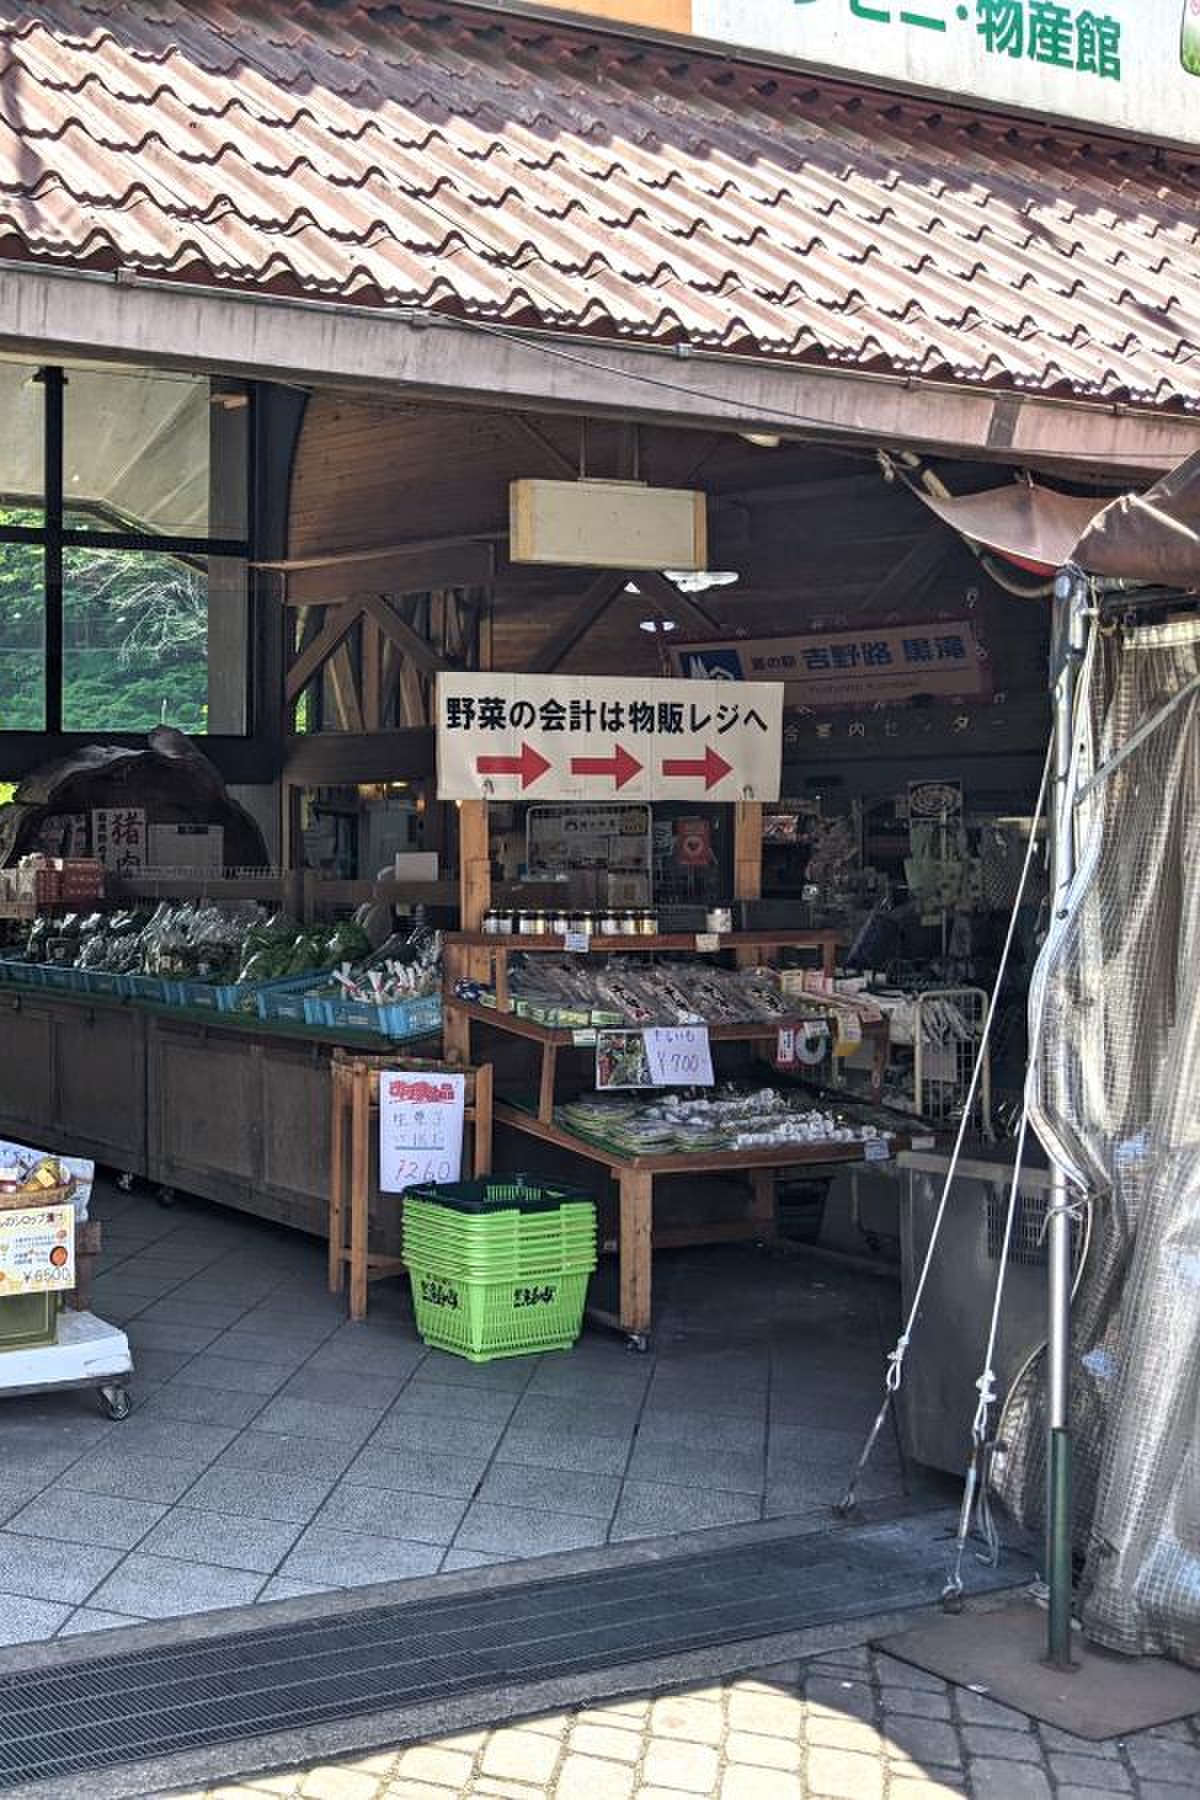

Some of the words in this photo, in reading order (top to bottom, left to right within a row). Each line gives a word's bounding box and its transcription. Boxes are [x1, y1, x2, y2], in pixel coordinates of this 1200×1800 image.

[803, 641, 892, 670] 吉野路
[445, 696, 769, 735] 野菜の会計は物販レジへ
